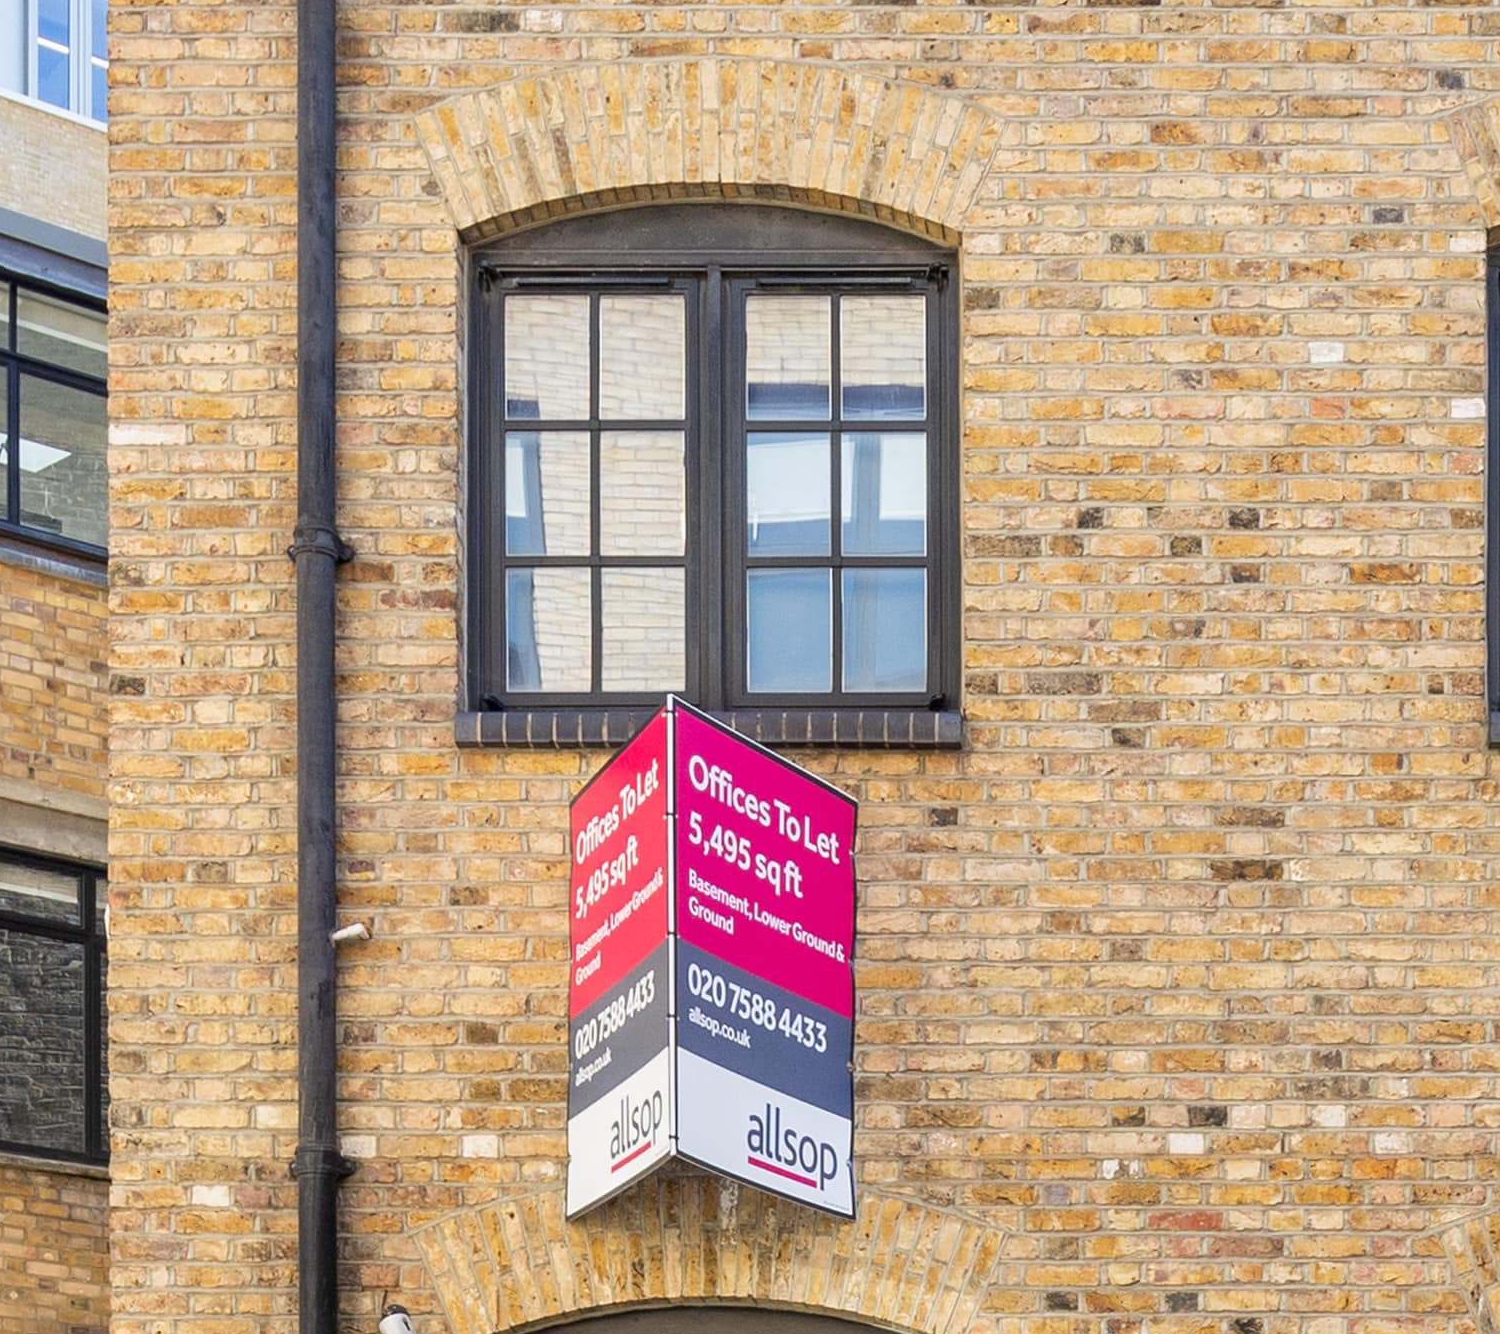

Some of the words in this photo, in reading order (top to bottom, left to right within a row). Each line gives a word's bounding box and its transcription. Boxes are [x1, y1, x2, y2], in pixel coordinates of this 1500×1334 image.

[576, 805, 619, 864] Offices
[620, 784, 636, 820] To
[637, 758, 659, 806] Let
[688, 754, 771, 827] Offices
[774, 798, 801, 842] To
[804, 815, 840, 864] Let
[575, 861, 609, 919] 5,495
[610, 852, 626, 885] sq
[627, 835, 639, 871] ft
[688, 810, 751, 871] 5,495
[755, 853, 781, 896] sq
[784, 859, 804, 898] ft
[610, 900, 633, 930] Lower
[688, 867, 752, 922] Basement,
[754, 901, 792, 936] Lower
[792, 922, 836, 958] Ground
[836, 942, 845, 963] &
[688, 896, 734, 935] Ground
[575, 950, 601, 986] Ground
[688, 963, 726, 1007] 020
[729, 982, 776, 1031] 7588
[778, 1008, 827, 1053] 4433
[575, 1019, 597, 1059] 020
[597, 995, 626, 1042] 7588
[626, 970, 655, 1019] 4433
[688, 1006, 751, 1048] allsop.co.uk
[575, 1048, 613, 1087] allsop.co.uk
[610, 1090, 663, 1159] allsop
[747, 1103, 837, 1191] allsop
